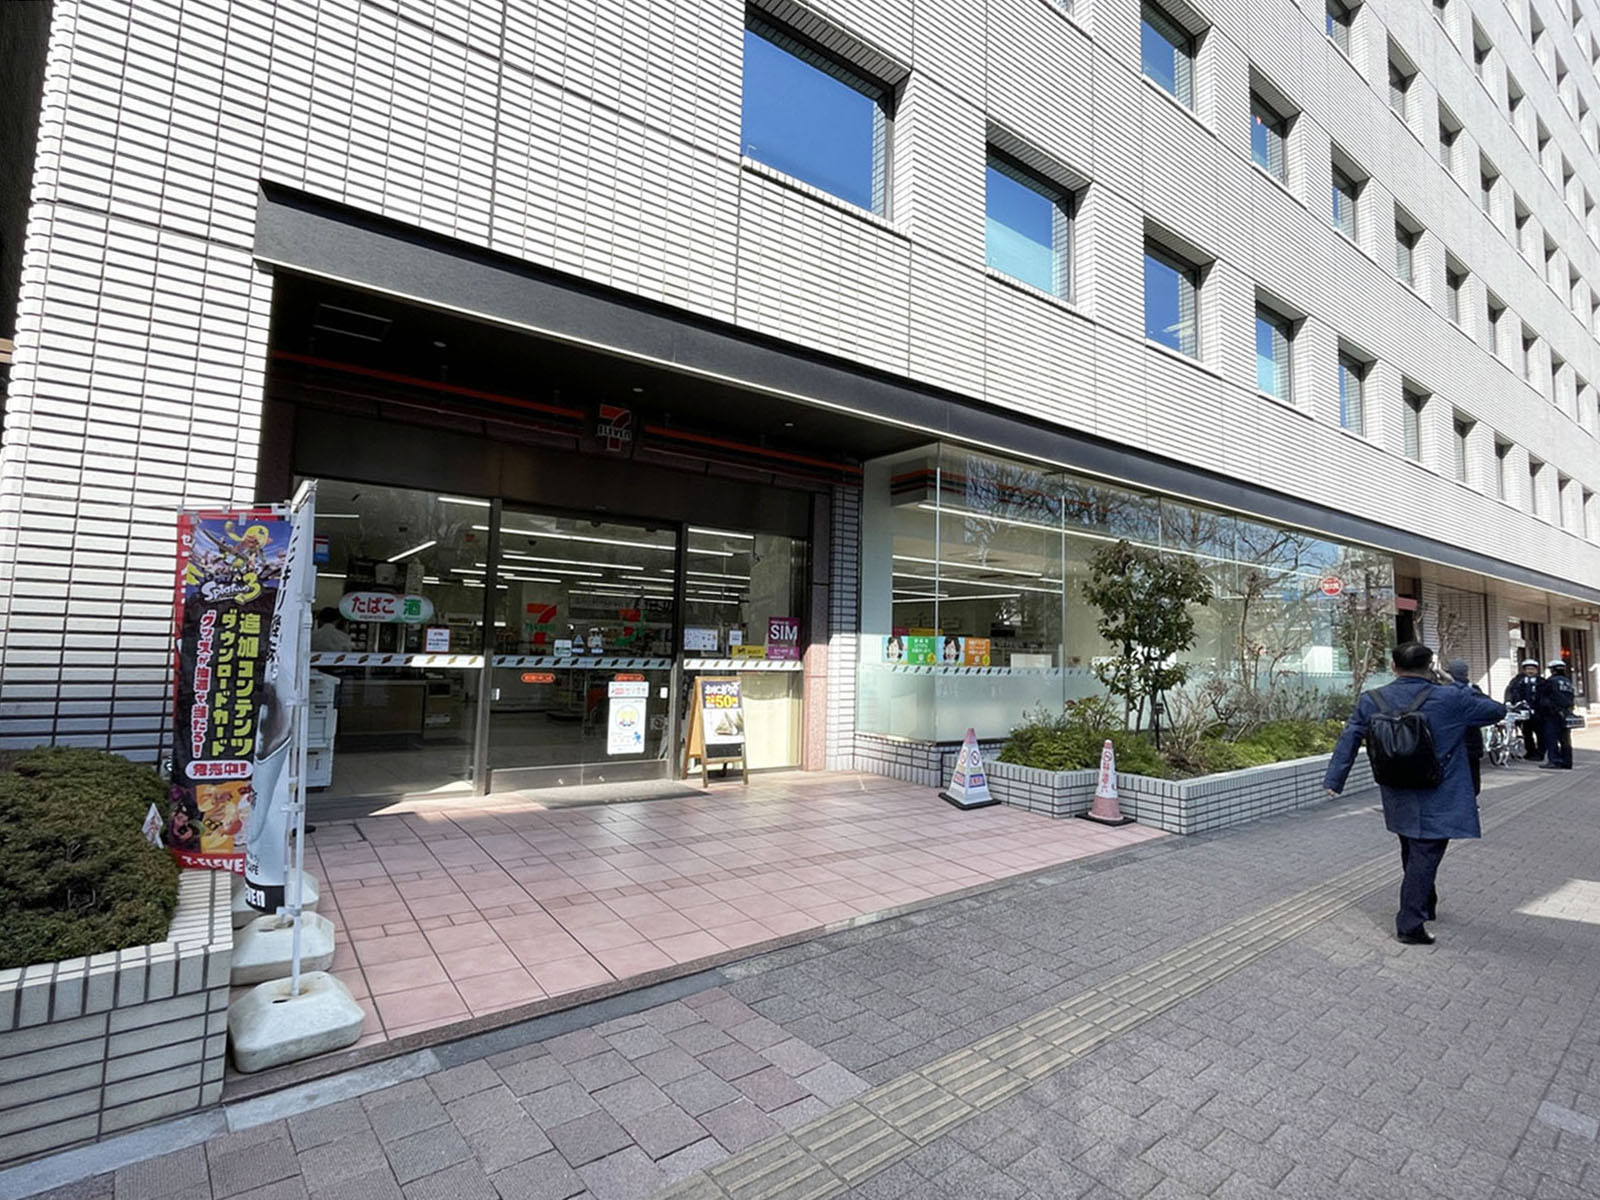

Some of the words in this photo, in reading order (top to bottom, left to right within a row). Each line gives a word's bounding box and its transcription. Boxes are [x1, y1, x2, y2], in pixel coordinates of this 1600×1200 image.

[234, 572, 262, 605] 3
[352, 595, 395, 614] たばこ
[403, 598, 421, 616] 酒
[770, 624, 798, 641] SIM
[211, 608, 238, 757] ダウンロードカード
[231, 612, 261, 757] 追加コンテンツ
